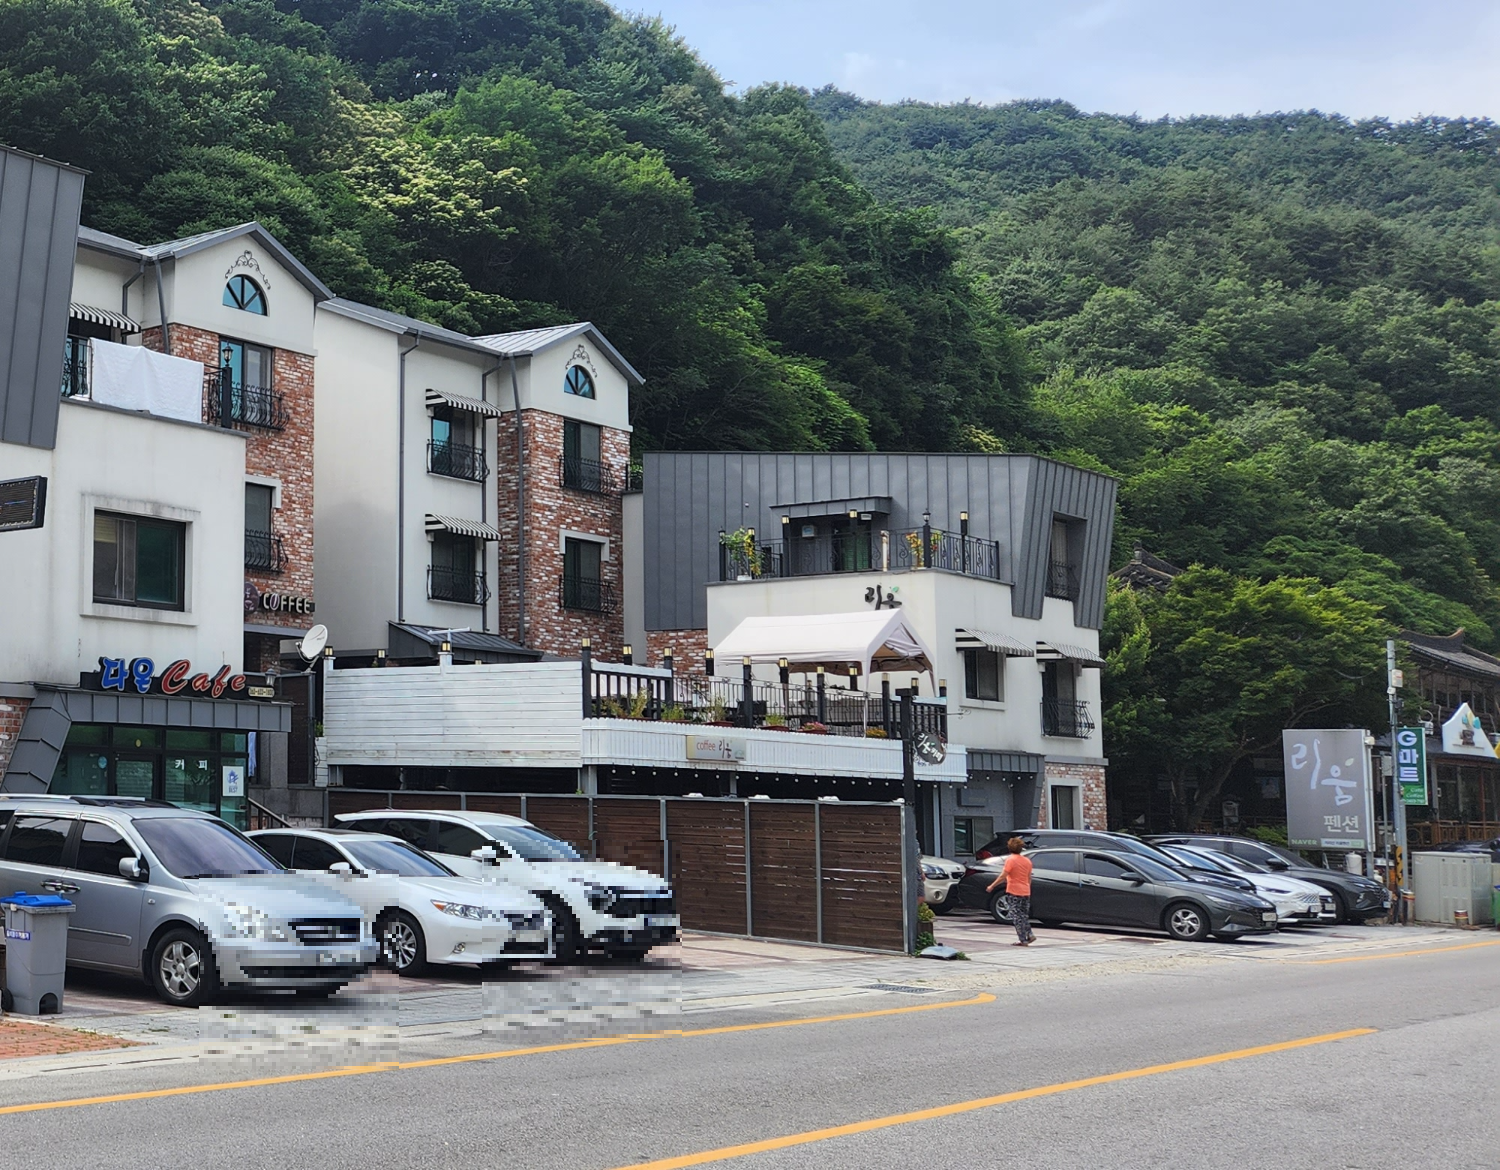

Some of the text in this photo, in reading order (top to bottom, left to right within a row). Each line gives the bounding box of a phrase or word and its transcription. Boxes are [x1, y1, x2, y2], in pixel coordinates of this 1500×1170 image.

[263, 593, 311, 614] COFFEE
[102, 657, 246, 698] 다온 Cafe
[697, 740, 716, 751] coffee
[1290, 738, 1357, 806] 리움
[1323, 815, 1359, 833] 펜션
